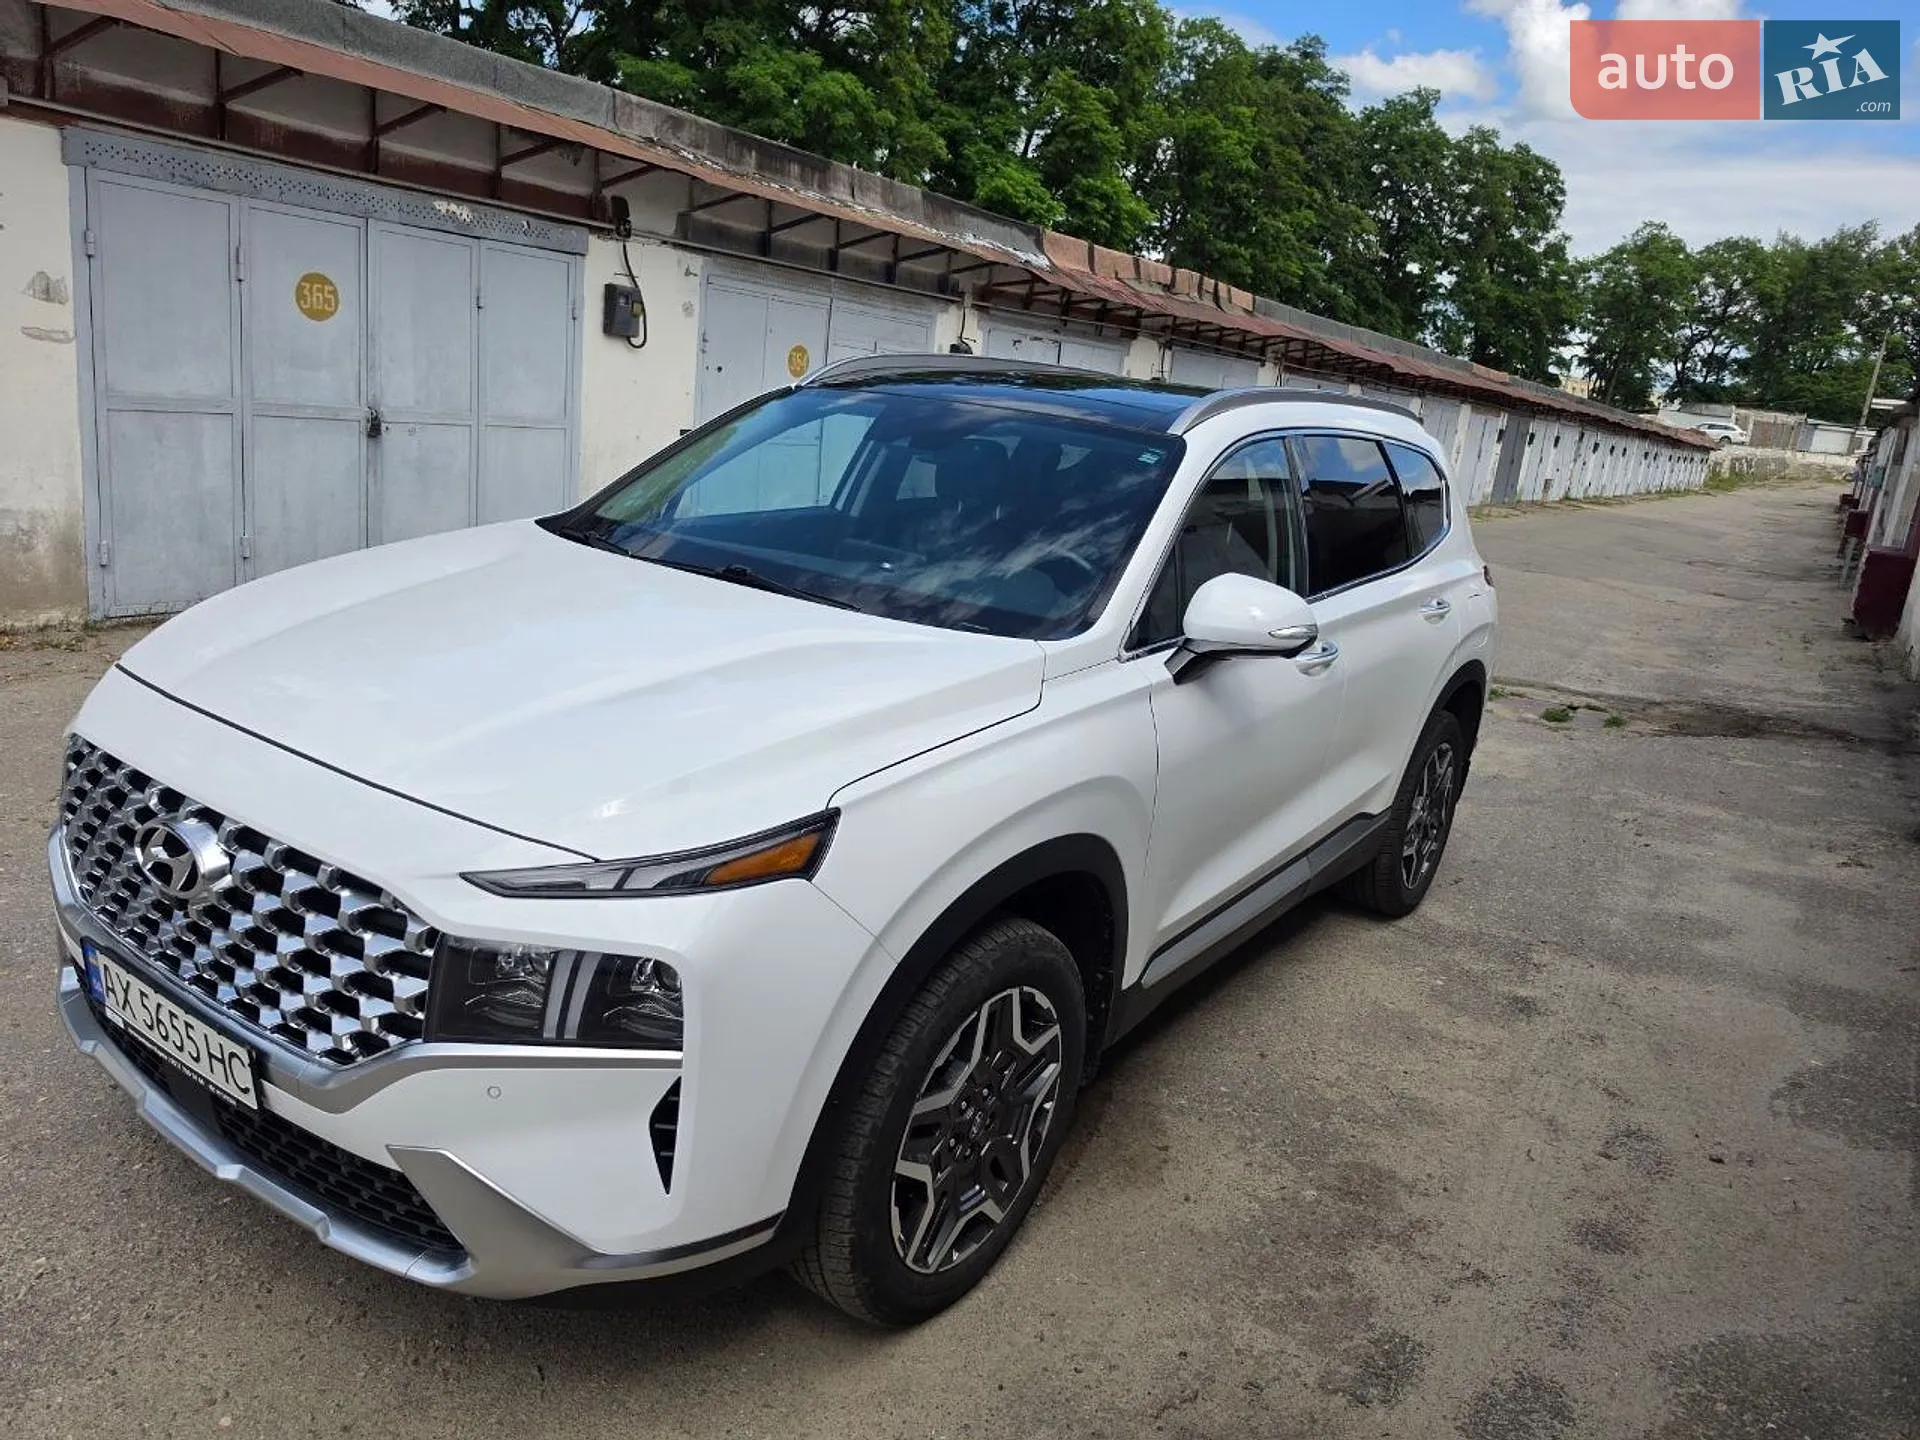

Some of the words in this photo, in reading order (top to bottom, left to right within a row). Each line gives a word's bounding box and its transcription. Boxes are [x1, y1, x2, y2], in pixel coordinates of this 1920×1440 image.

[300, 282, 335, 312] 365
[103, 963, 137, 1020] AX
[139, 988, 202, 1064] 5655
[204, 1033, 251, 1095] HC
